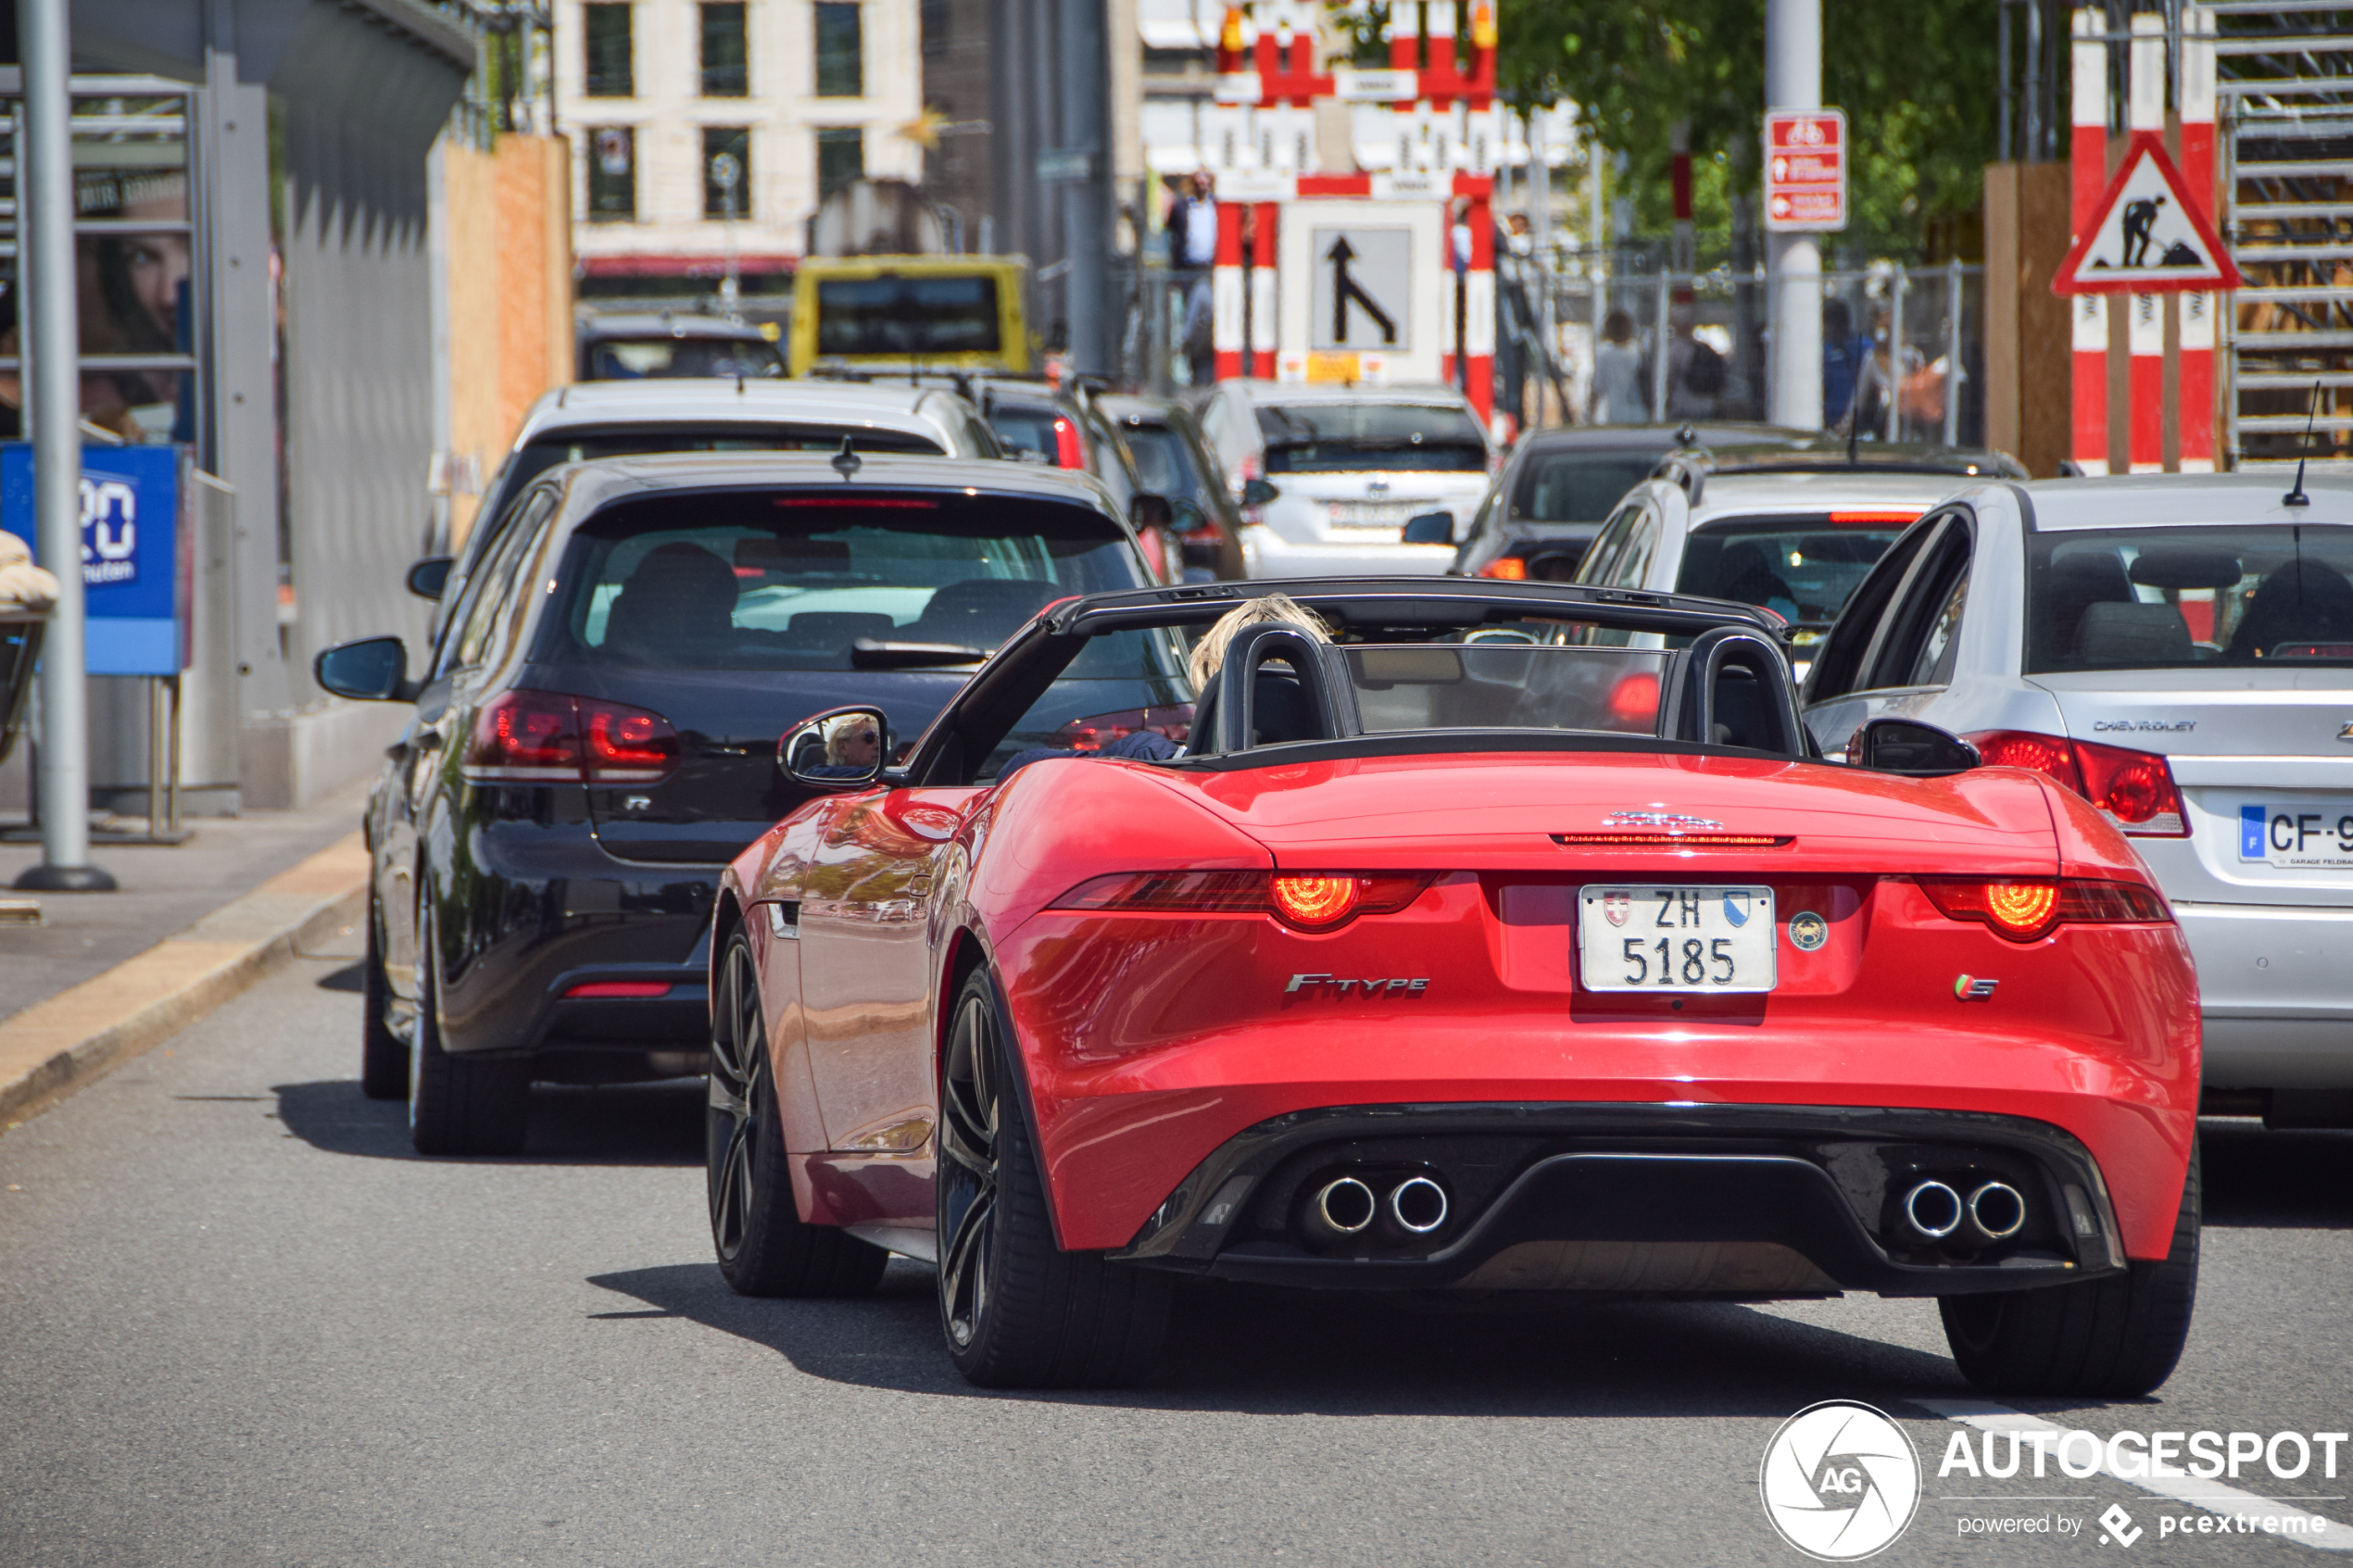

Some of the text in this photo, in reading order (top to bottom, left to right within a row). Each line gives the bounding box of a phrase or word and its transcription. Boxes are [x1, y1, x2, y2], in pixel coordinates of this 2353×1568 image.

[2094, 721, 2196, 732] CHEVROLET
[624, 796, 650, 810] R
[2249, 836, 2258, 849] F
[1655, 891, 1700, 927] ZH
[1623, 938, 1735, 985] 5185
[1285, 973, 1430, 993] F-TYPE
[1968, 979, 1999, 996] S
